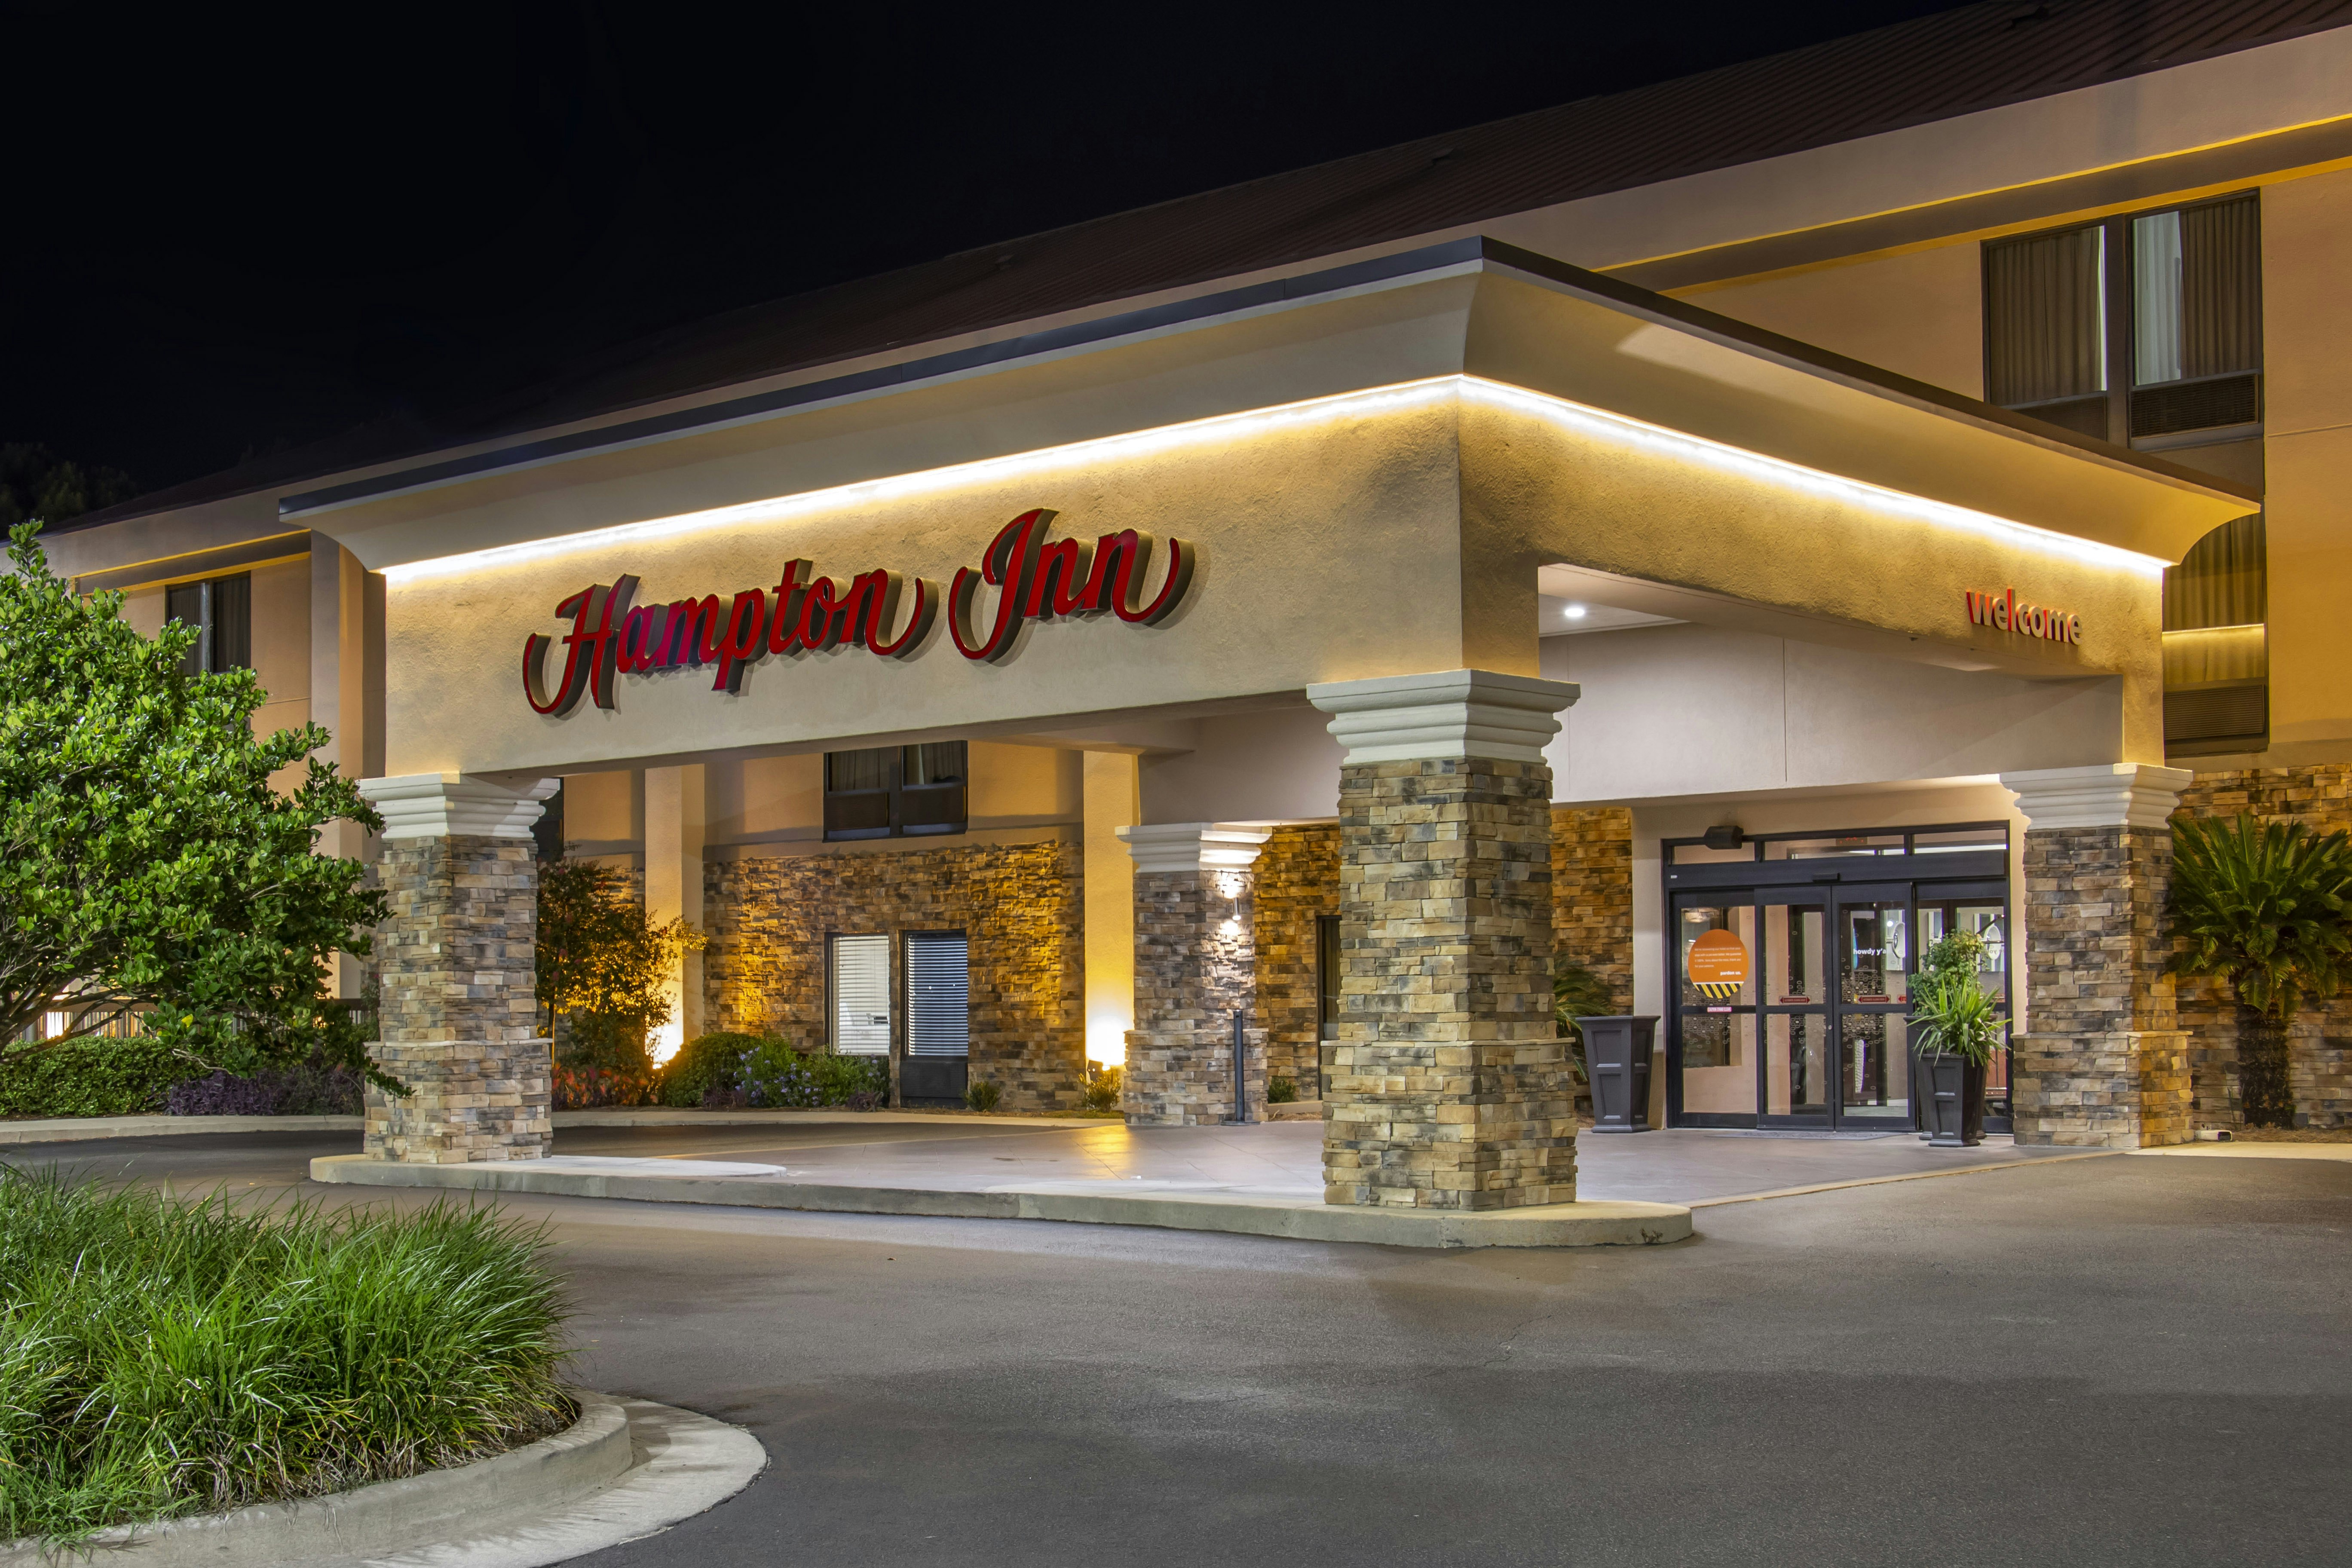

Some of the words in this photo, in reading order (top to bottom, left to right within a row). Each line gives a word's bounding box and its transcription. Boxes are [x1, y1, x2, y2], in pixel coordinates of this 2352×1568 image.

[522, 558, 934, 714] Hampton
[948, 508, 1190, 660] Inn
[1966, 588, 2082, 645] welcome
